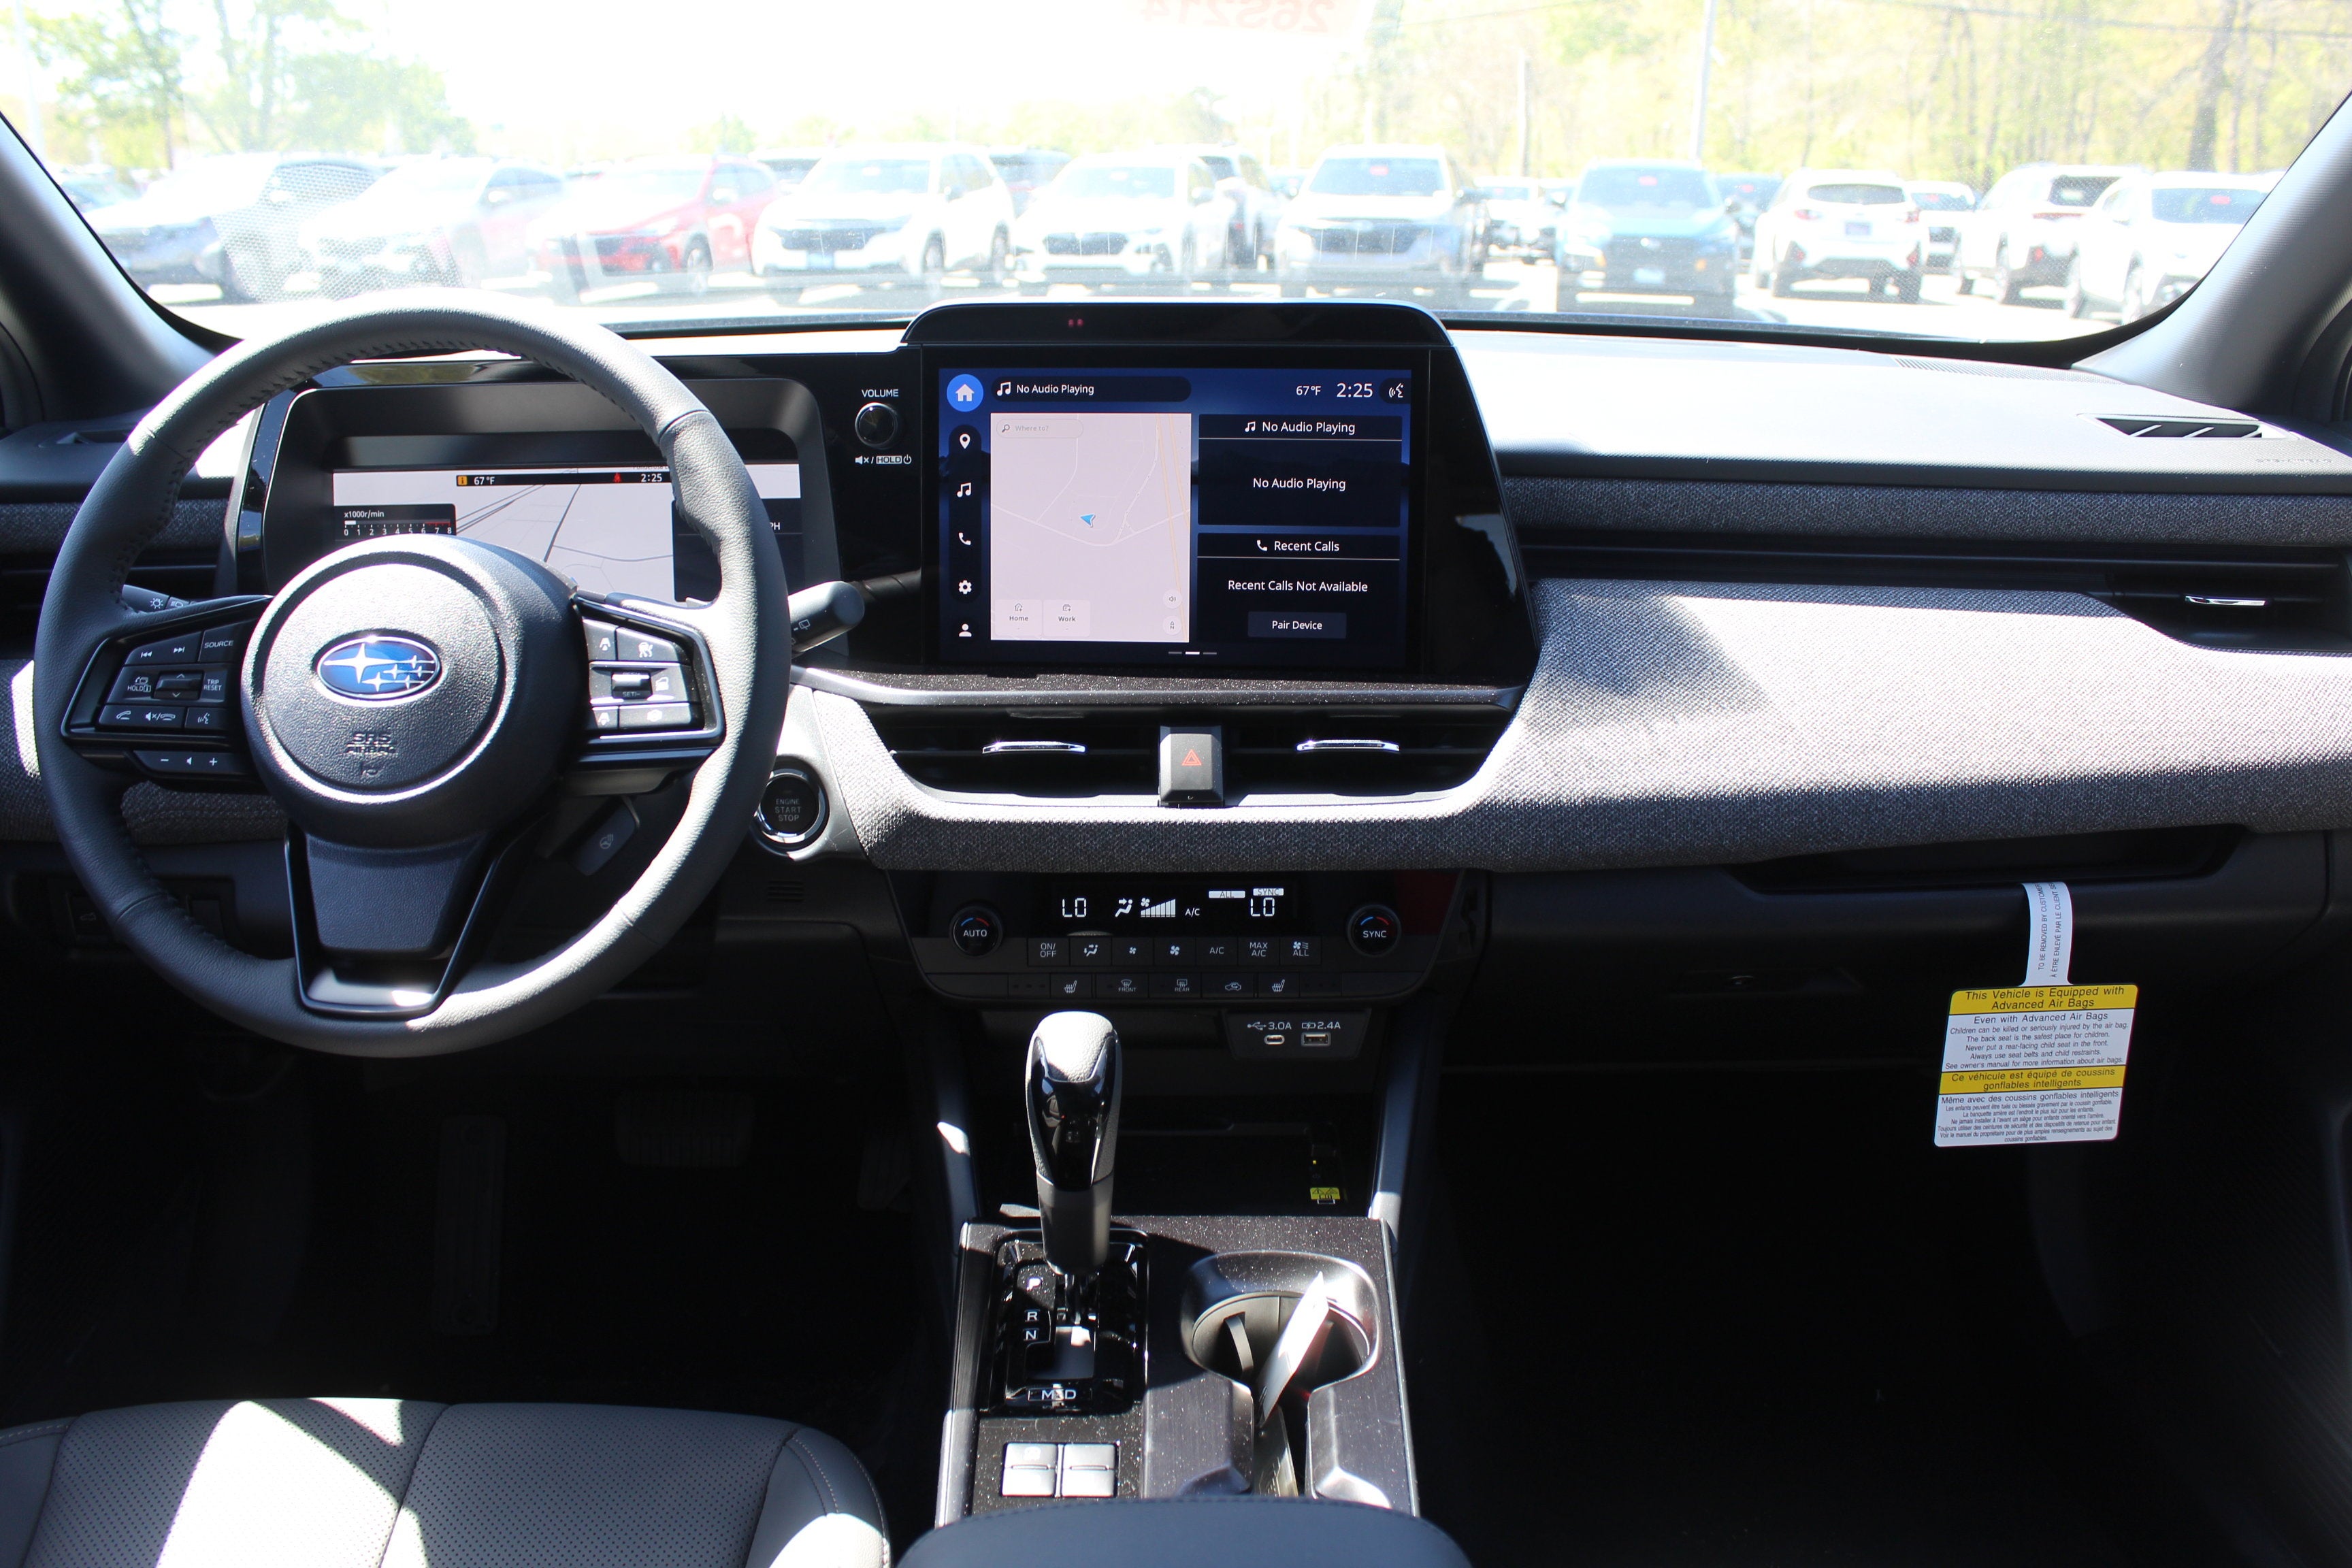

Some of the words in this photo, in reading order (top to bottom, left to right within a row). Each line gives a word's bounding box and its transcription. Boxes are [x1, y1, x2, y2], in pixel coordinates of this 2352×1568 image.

[862, 389, 899, 397] VOLUME
[1017, 385, 1029, 393] No
[1032, 385, 1059, 393] Audio
[1061, 385, 1094, 396] Playing
[1296, 386, 1321, 396] 67°F
[1337, 383, 1373, 398] 2:25
[1262, 422, 1278, 432] No
[1281, 422, 1312, 432] Audio
[1316, 422, 1355, 435] Playing
[641, 473, 663, 482] 2:25
[1253, 478, 1269, 488] No
[1272, 478, 1303, 488] Audio
[1307, 478, 1346, 491] Playing
[1274, 541, 1311, 551] Recent
[1314, 542, 1340, 551] Calls
[1228, 580, 1265, 590] Recent
[1268, 581, 1293, 591] Calls
[1296, 581, 1316, 591] Not
[1319, 582, 1368, 592] Available
[1272, 621, 1290, 629] Pair
[1293, 621, 1323, 630] Device
[353, 732, 391, 743] SRS
[2052, 891, 2061, 910] CLIENT
[1185, 908, 1200, 917] A/C
[2038, 962, 2044, 970] TO
[1965, 990, 1987, 999] This
[1992, 988, 2030, 998] Vehicle
[2035, 988, 2044, 997] is
[2049, 986, 2098, 998] Equipped
[2103, 985, 2125, 995] with
[1991, 999, 2044, 1009] Advanced
[2048, 998, 2063, 1007] Air
[2067, 997, 2095, 1008] Bags
[1973, 1015, 1996, 1023] Even
[2000, 1014, 2018, 1022] with
[2021, 1012, 2066, 1022] Advanced
[2069, 1012, 2082, 1020] Air
[2085, 1011, 2108, 1021] Bags
[2030, 1023, 2056, 1032] seriously
[2059, 1022, 2080, 1031] injured
[2082, 1022, 2090, 1031] by
[2115, 1021, 2129, 1030] bag.
[2054, 1031, 2071, 1040] place
[1986, 1042, 1996, 1051] put
[2005, 1041, 2038, 1050] rear-facing
[1970, 1051, 1992, 1060] Always
[2072, 1047, 2101, 1055] restraints.
[2040, 1057, 2075, 1065] information
[2106, 1056, 2123, 1064] bags.
[1950, 1072, 1964, 1081] Ce
[1968, 1070, 2006, 1080] véhicule
[2009, 1069, 2024, 1079] est
[2027, 1068, 2057, 1080] équipé
[2060, 1068, 2072, 1077] de
[2075, 1066, 2116, 1076] coussins
[1982, 1079, 2029, 1090] gonflables
[2033, 1077, 2082, 1088] intelligents
[1940, 1095, 1964, 1103] Même
[1988, 1093, 2002, 1101] des
[2004, 1092, 2037, 1101] coussins
[2039, 1090, 2077, 1101] gonflables
[2080, 1089, 2120, 1099] intelligents
[1027, 1311, 1038, 1321] R
[1025, 1330, 1036, 1339] N
[1065, 1389, 1076, 1400] D
